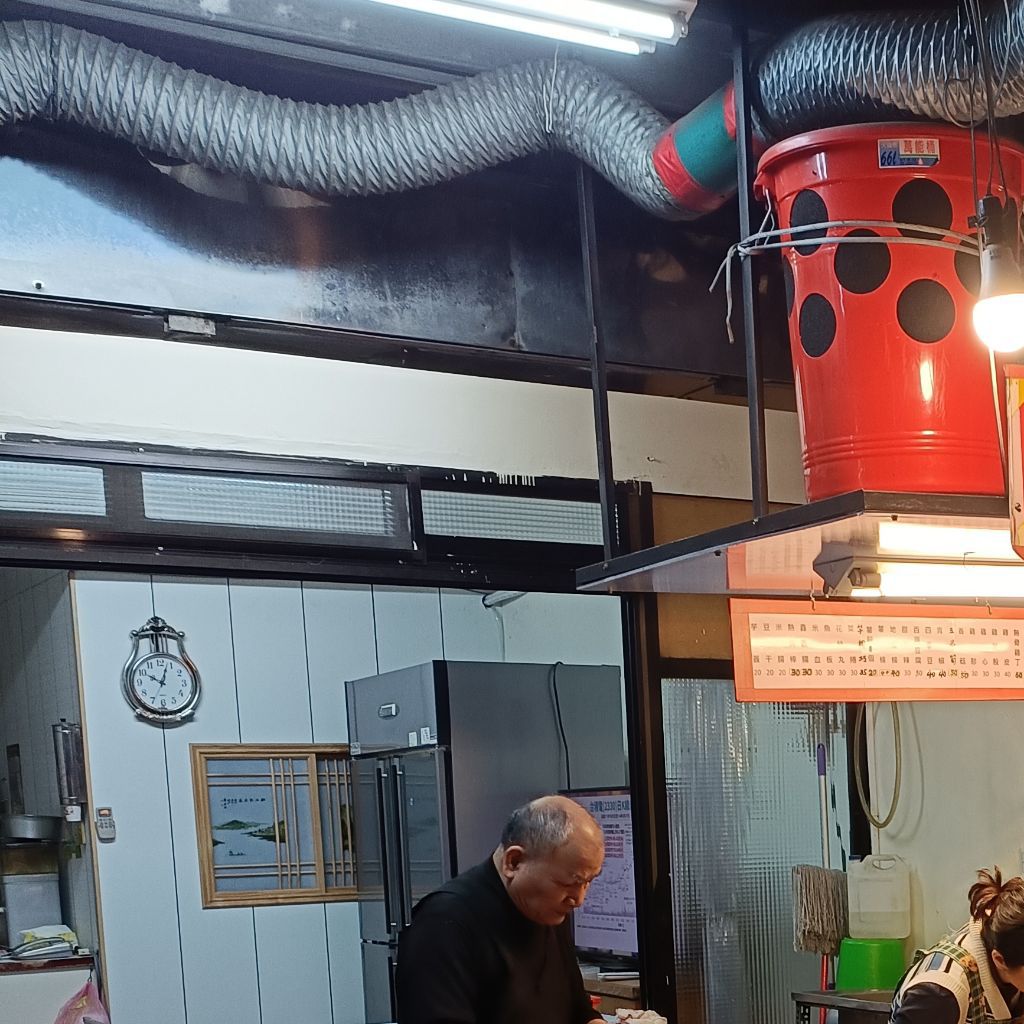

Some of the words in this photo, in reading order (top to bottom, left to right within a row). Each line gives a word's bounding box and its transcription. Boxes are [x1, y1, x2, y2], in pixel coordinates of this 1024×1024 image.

[146, 661, 153, 669] 11
[156, 659, 164, 667] 12
[136, 679, 142, 687] 9
[160, 699, 167, 707] 6
